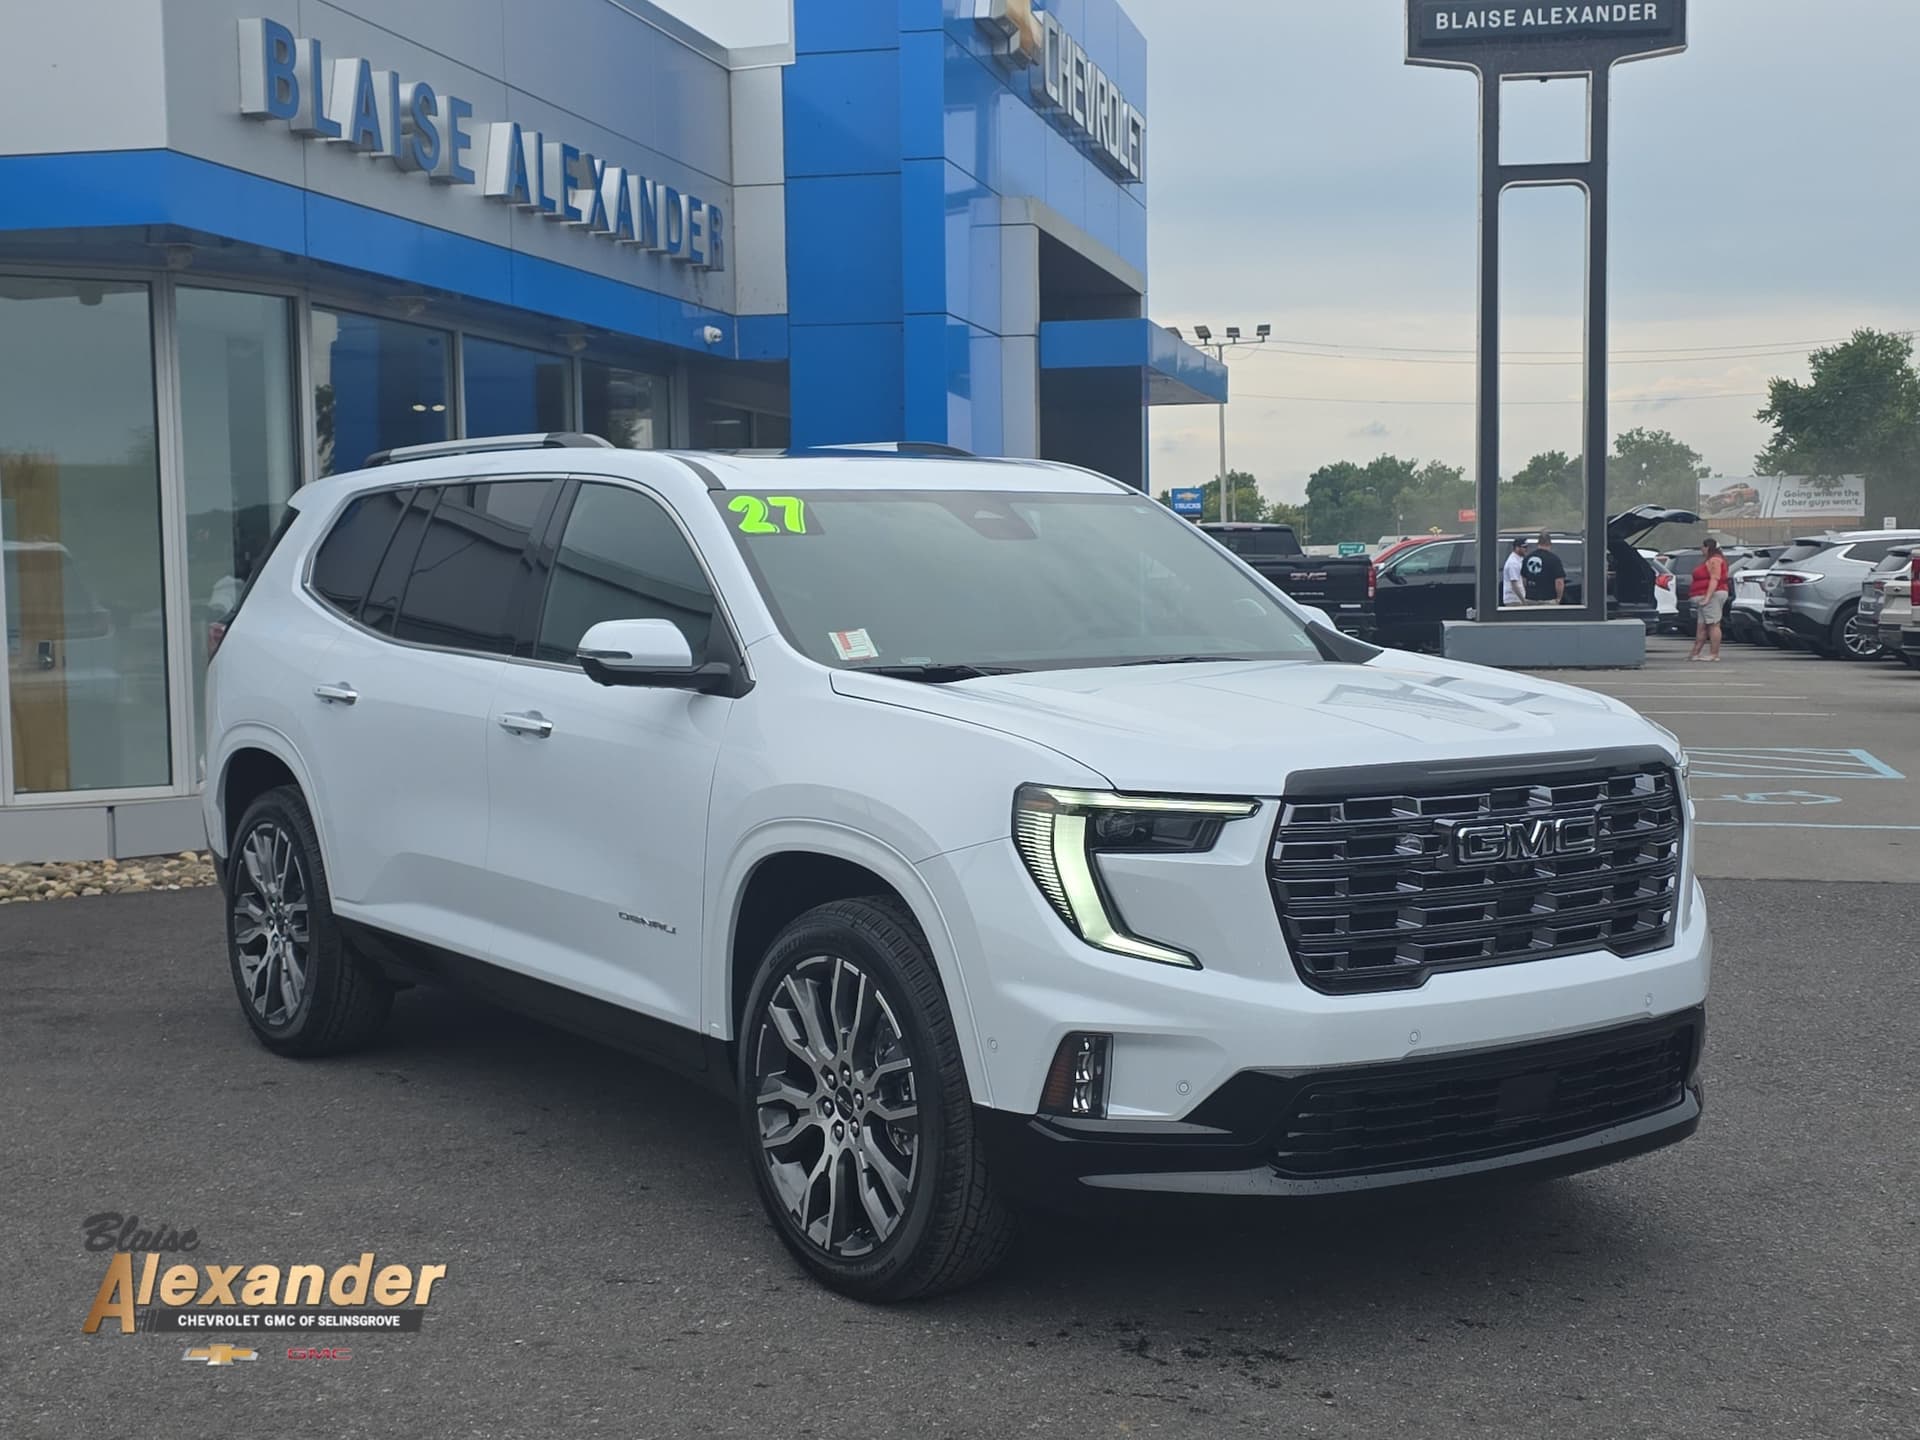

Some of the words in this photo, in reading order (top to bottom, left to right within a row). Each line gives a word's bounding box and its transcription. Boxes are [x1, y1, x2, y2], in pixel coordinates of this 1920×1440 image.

[1435, 9, 1517, 30] BLAISE
[1522, 3, 1658, 26] ALEXANDER
[1043, 10, 1146, 184] CHEVROLET
[258, 17, 476, 184] BLAISE
[500, 121, 725, 272] ALEXANDER
[1784, 489, 1812, 499] Going
[1844, 489, 1860, 497] the
[1808, 500, 1831, 508] guys
[727, 495, 807, 534] 27
[1457, 815, 1597, 864] GMC
